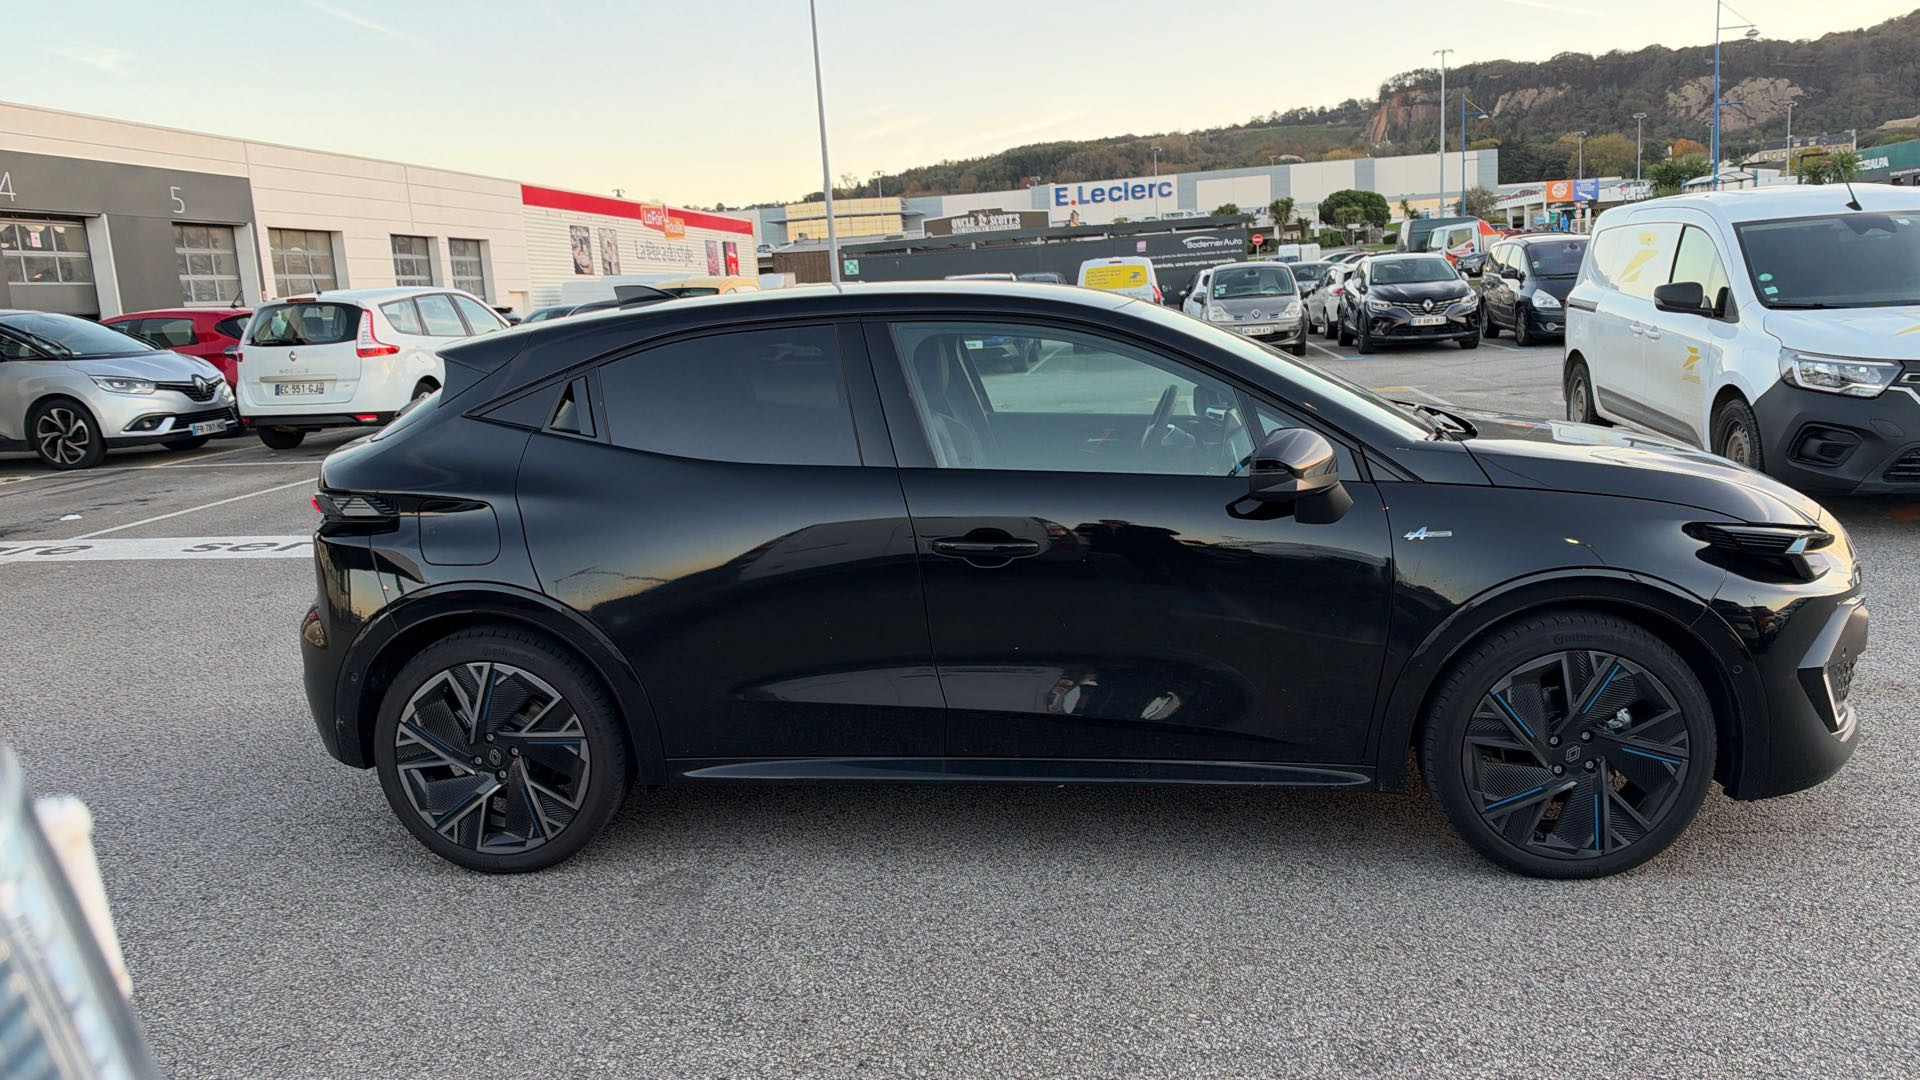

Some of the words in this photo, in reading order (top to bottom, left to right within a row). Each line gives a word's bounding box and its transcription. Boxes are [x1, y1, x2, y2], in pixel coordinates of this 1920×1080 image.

[0, 171, 17, 202] 4
[1054, 181, 1173, 207] E.Leclerc
[170, 186, 186, 214] 5
[989, 213, 1021, 226] SCOTT'S
[280, 383, 318, 395] EC-551-GJ
